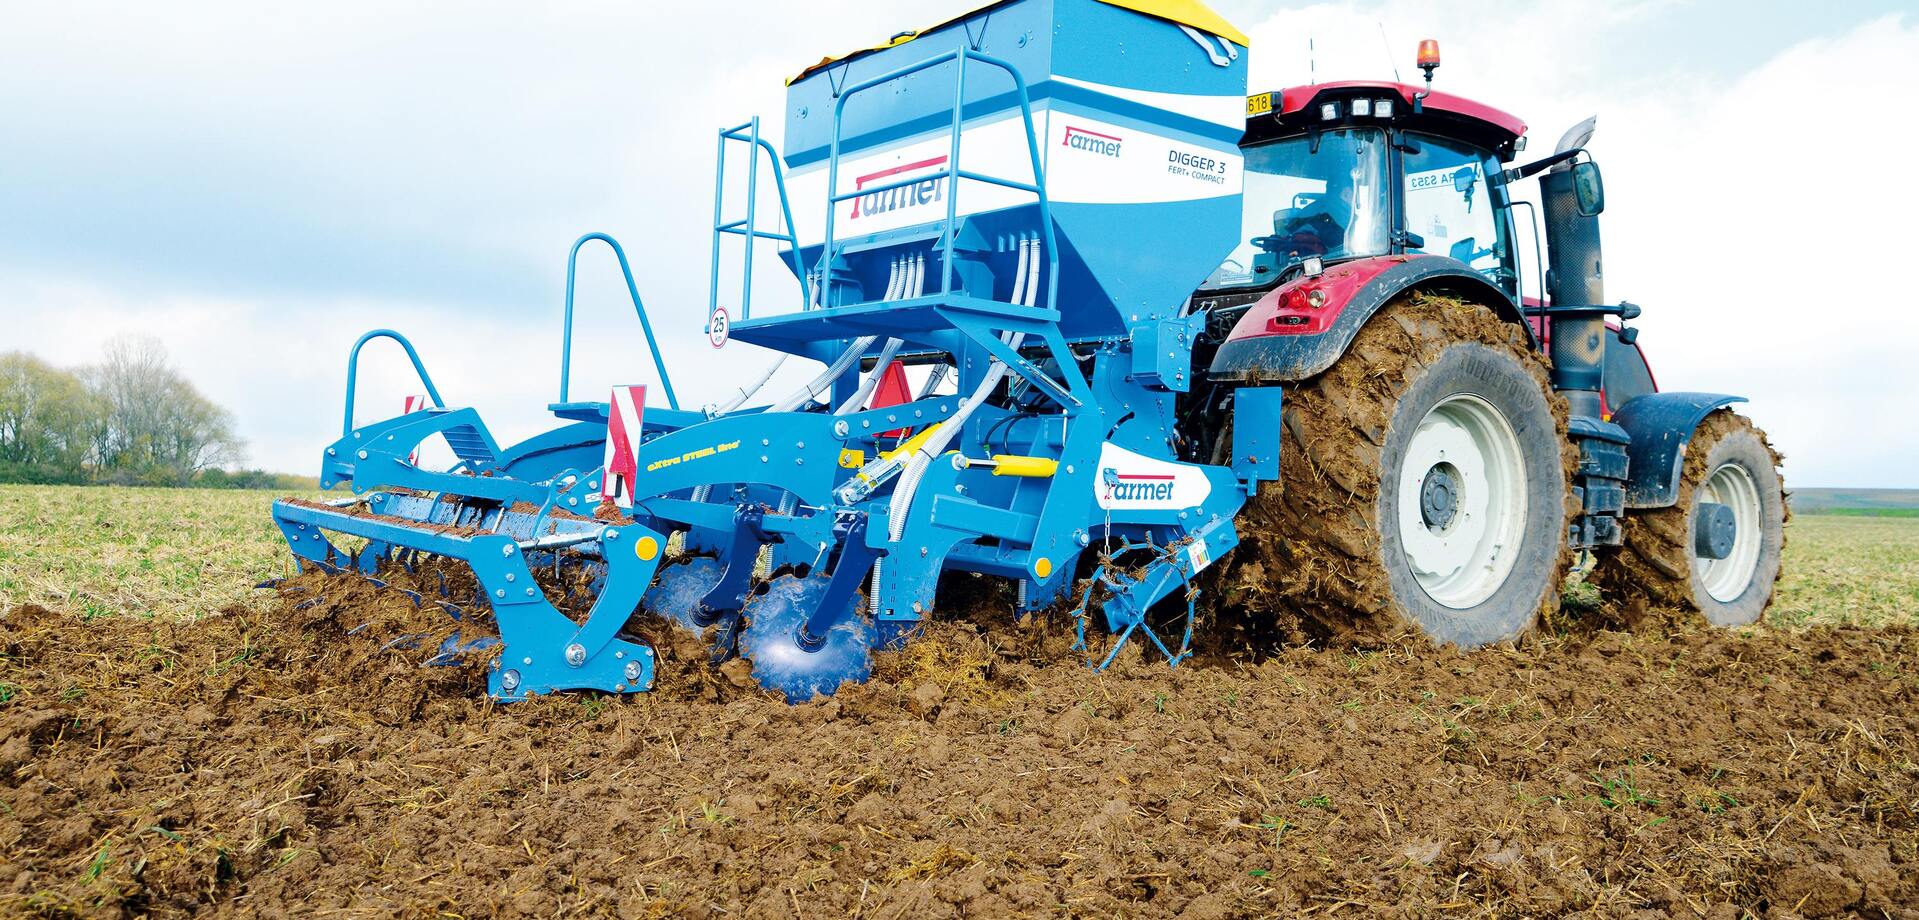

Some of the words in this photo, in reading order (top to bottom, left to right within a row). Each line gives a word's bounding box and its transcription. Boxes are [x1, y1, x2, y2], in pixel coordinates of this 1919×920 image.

[1248, 96, 1267, 112] 618
[1062, 126, 1122, 158] Farmet
[1168, 150, 1215, 172] DIGGER
[1217, 161, 1226, 174] 3
[1191, 171, 1225, 185] COMPACT
[713, 316, 725, 333] 25
[682, 447, 717, 462] STEEL
